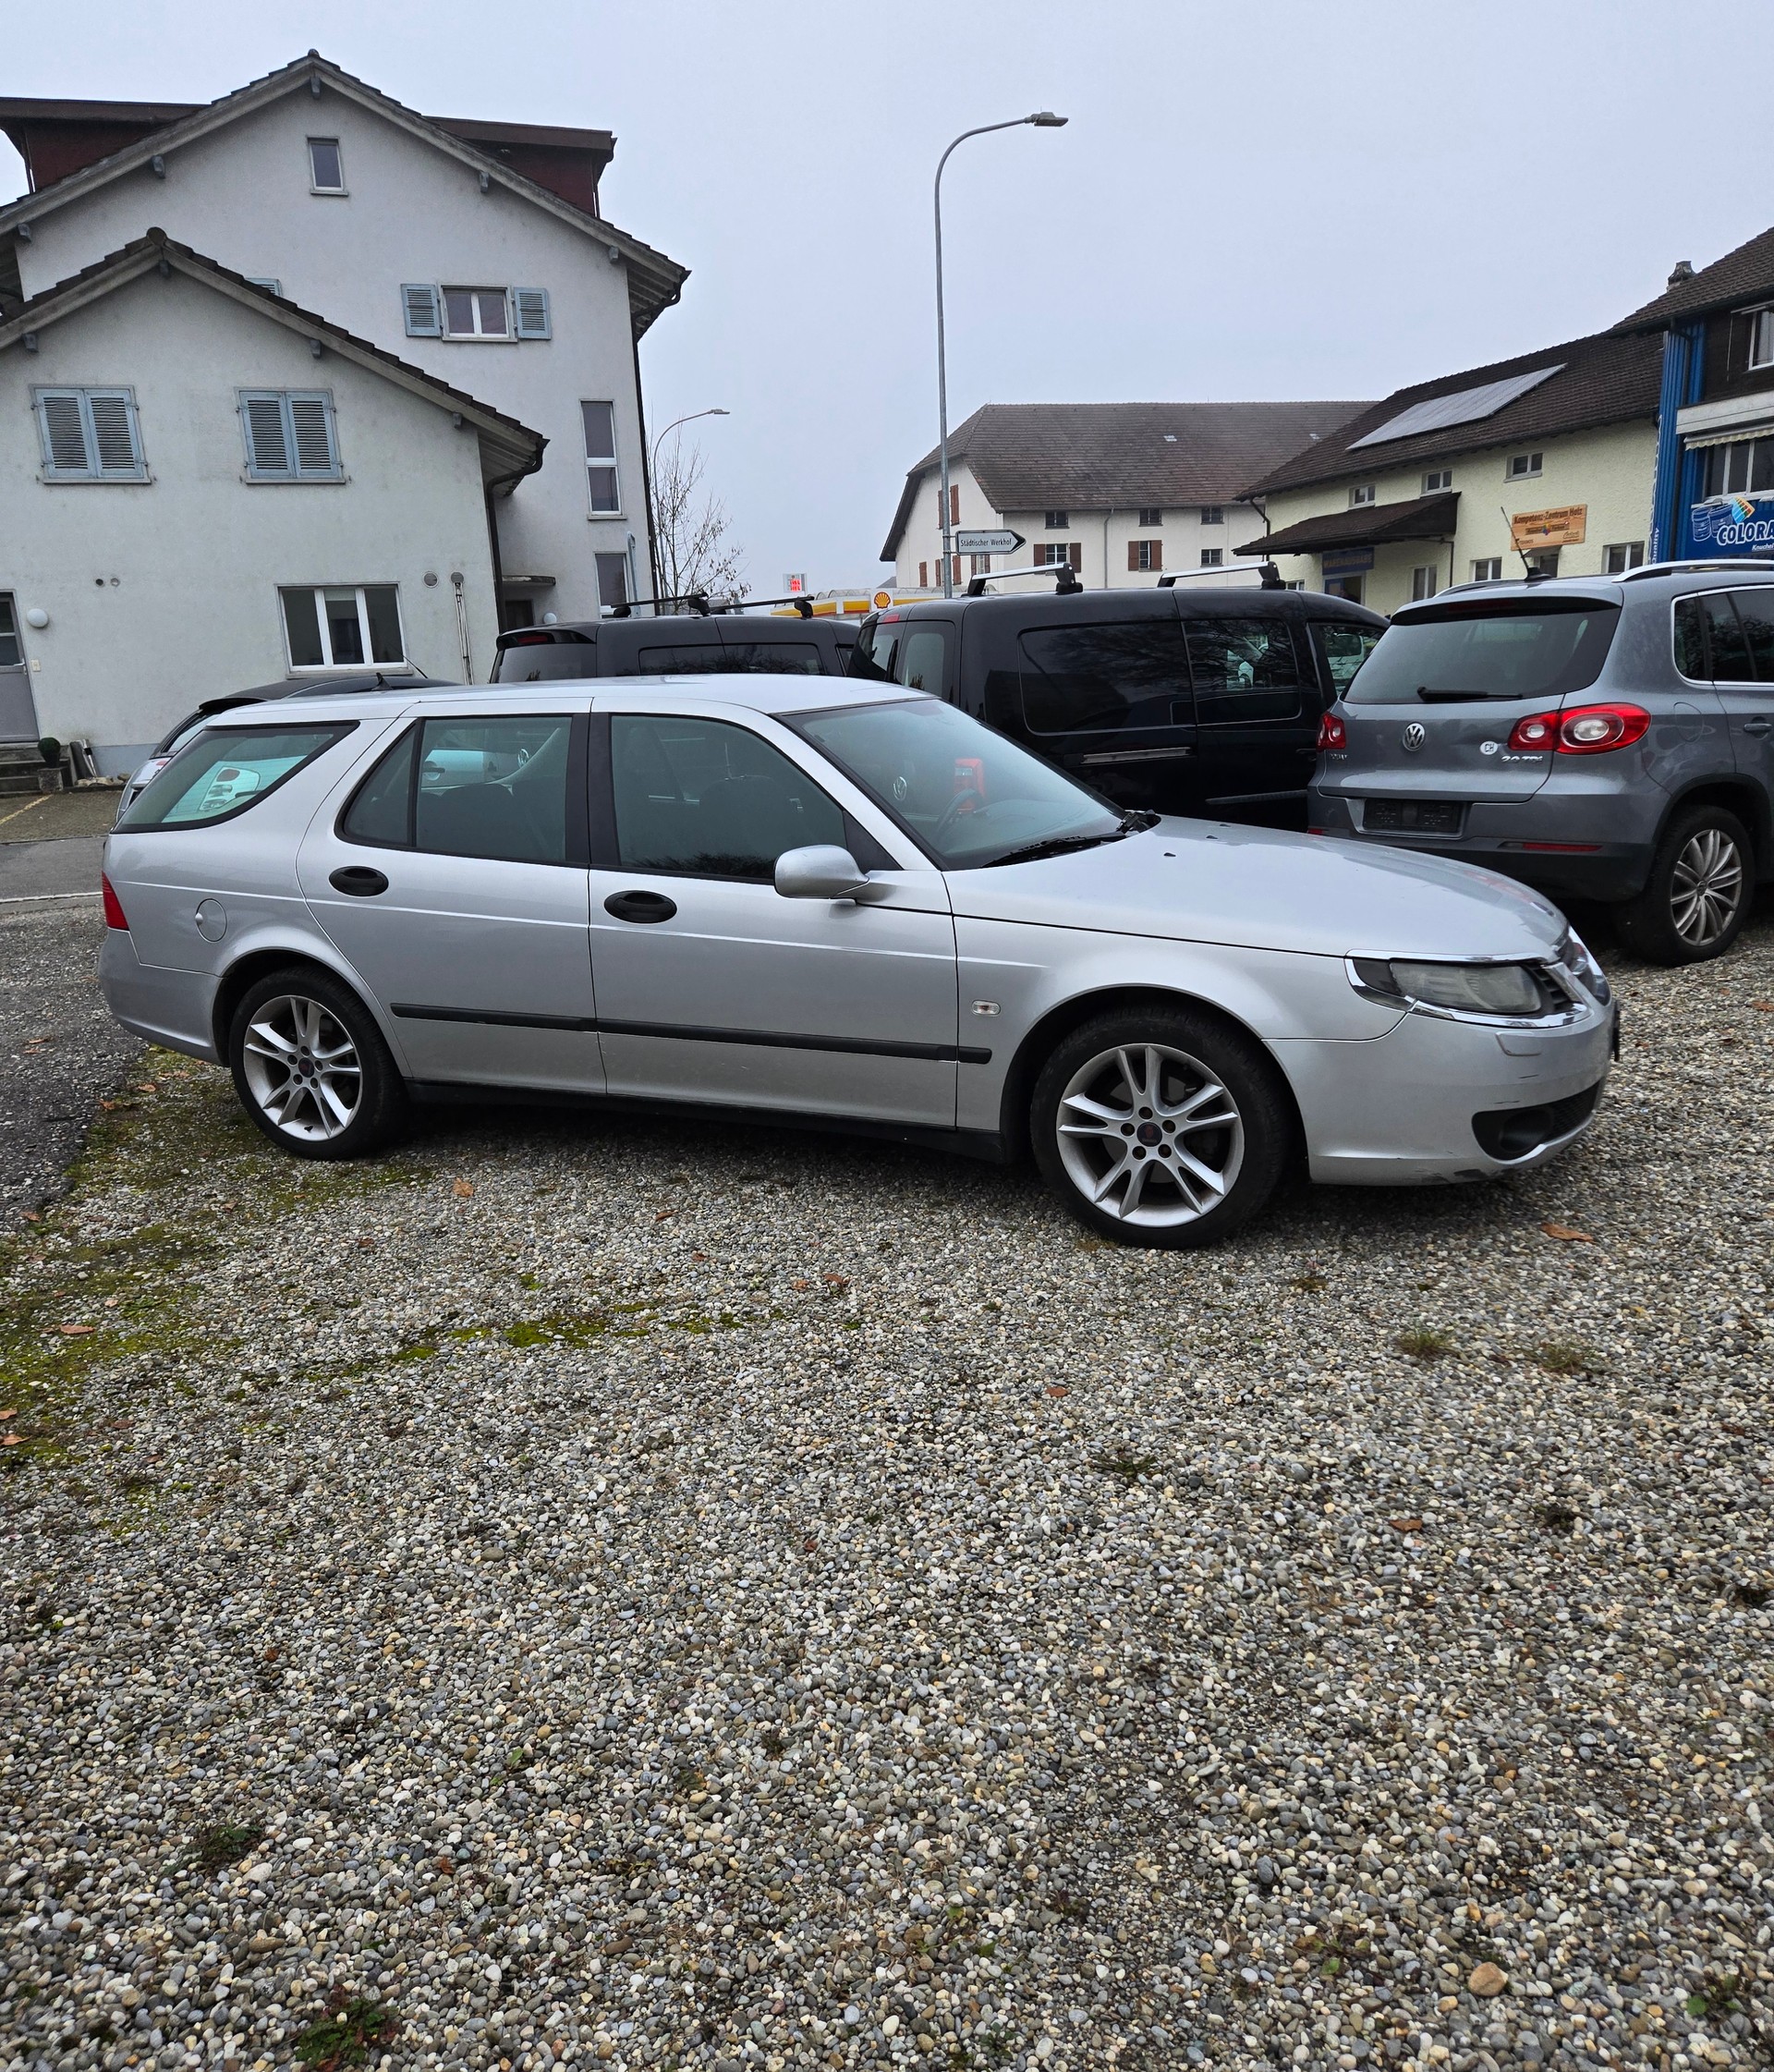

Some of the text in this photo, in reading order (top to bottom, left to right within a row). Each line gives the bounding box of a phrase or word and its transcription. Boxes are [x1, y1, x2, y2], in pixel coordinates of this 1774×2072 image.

[1570, 507, 1583, 517] Holz
[960, 538, 1013, 547] Städtischer Werkhof
